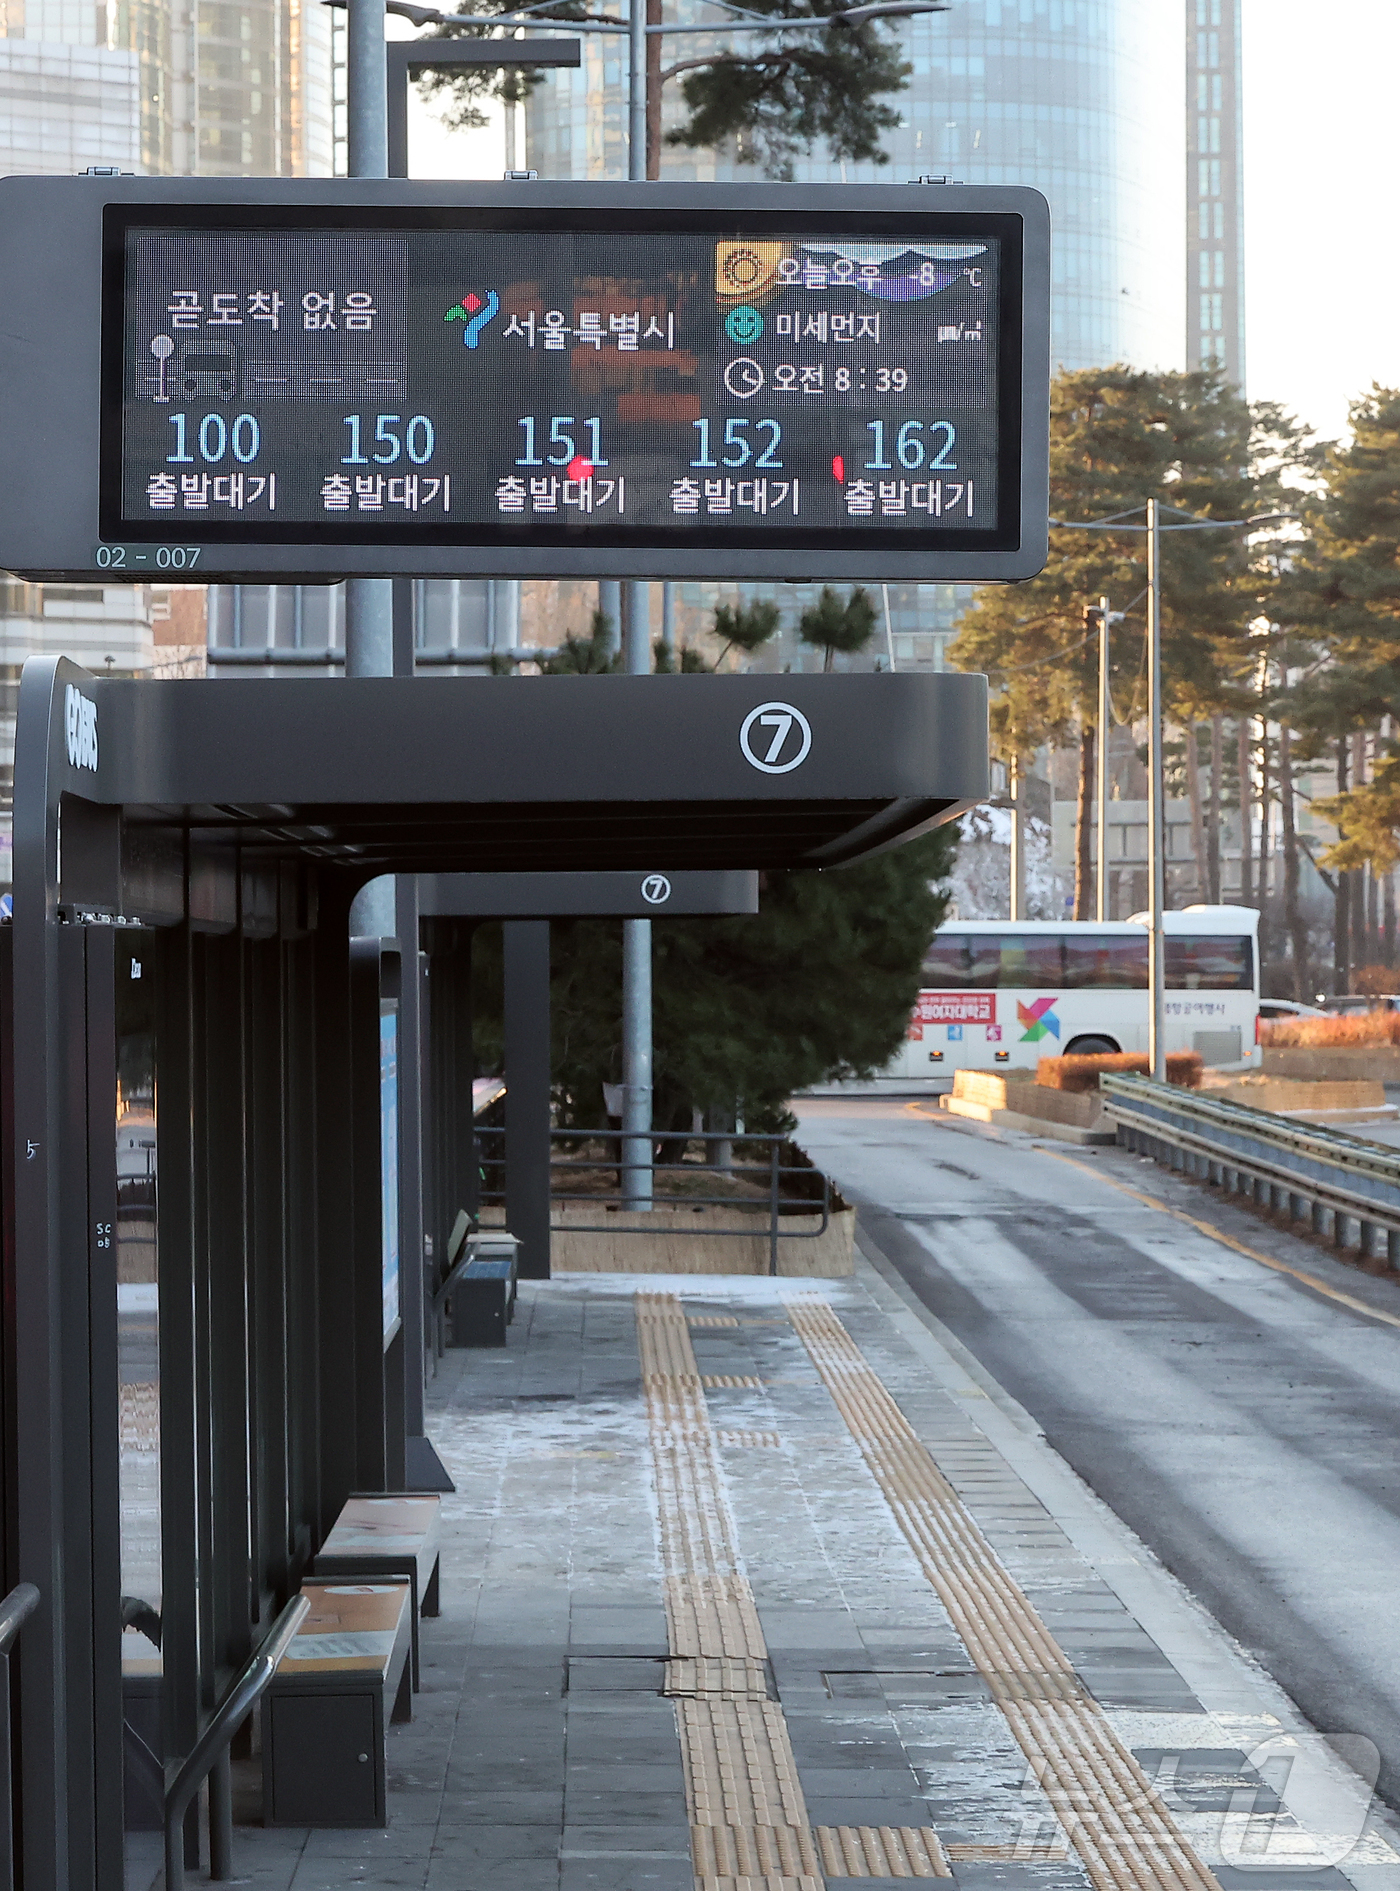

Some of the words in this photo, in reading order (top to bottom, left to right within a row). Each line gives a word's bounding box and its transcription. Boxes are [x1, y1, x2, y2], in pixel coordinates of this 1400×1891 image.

[167, 289, 284, 331] 곧도착
[301, 290, 377, 331] 없음
[776, 311, 881, 344] 미세먼지
[502, 310, 674, 351] 서울특별시
[772, 363, 825, 393] 오전
[165, 413, 260, 463] 100
[340, 415, 434, 465] 150
[515, 416, 609, 466] 151
[689, 418, 783, 467] 152
[864, 420, 958, 470] 162
[146, 473, 275, 511] 출발대기
[321, 474, 450, 512] 출발대기
[495, 475, 624, 513] 출발대기
[669, 477, 799, 515] 출발대기
[843, 479, 973, 517] 출발대기
[96, 546, 126, 569] 02
[156, 547, 201, 569] 007
